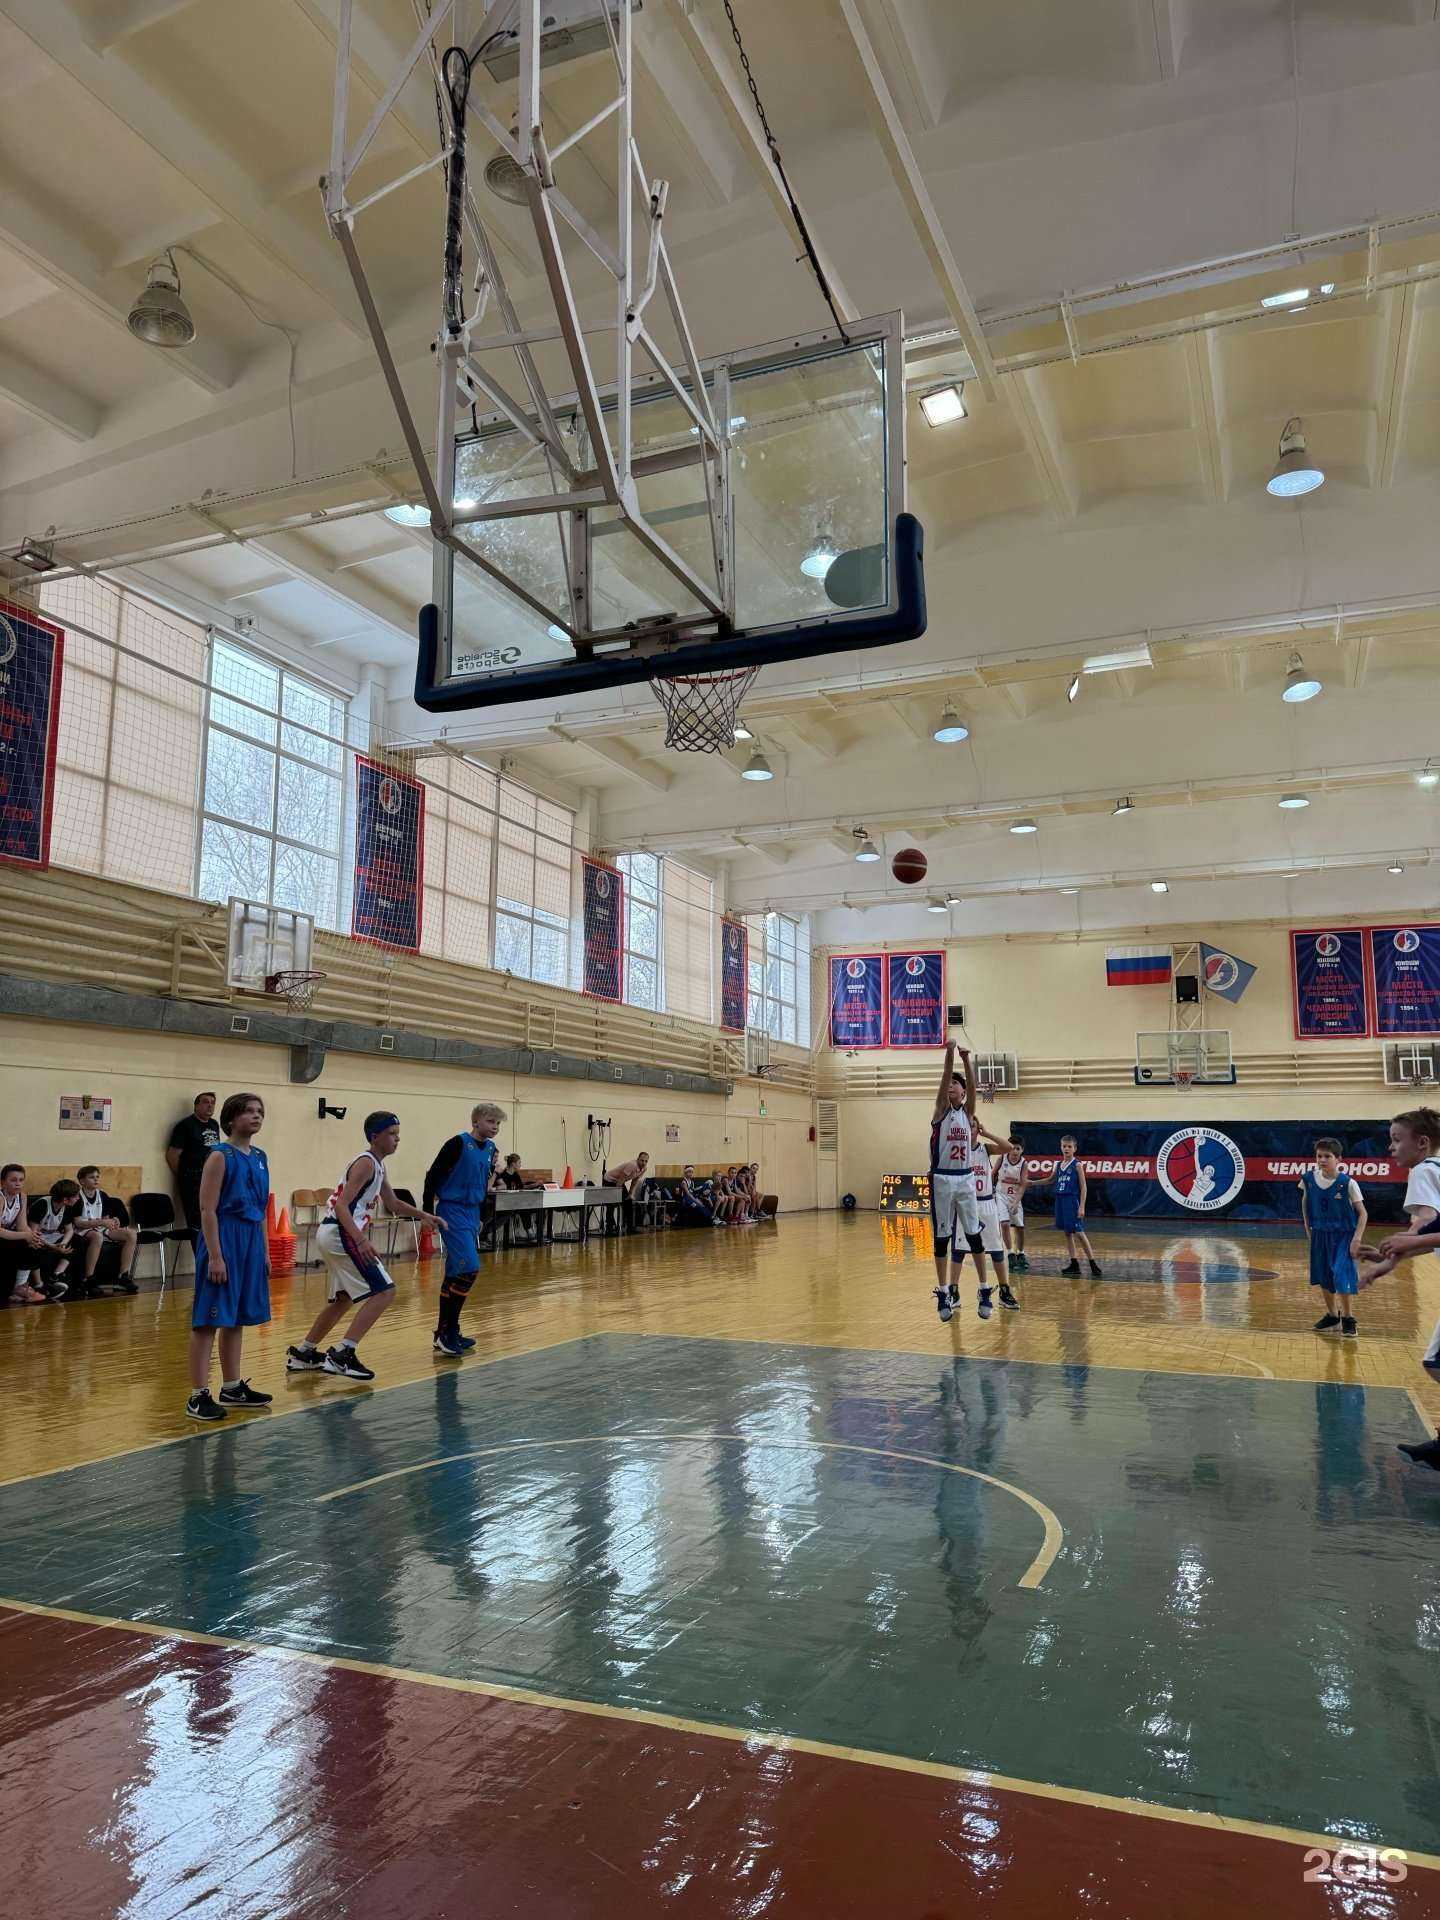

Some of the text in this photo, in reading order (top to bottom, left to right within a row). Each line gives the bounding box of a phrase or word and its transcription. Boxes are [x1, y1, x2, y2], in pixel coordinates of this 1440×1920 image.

[1267, 1161, 1391, 1176] ЧЕМПОНОВ
[883, 1186, 894, 1195] 11
[918, 1187, 930, 1196] 16
[880, 1198, 888, 1206] 4
[896, 1199, 919, 1209] 6:48
